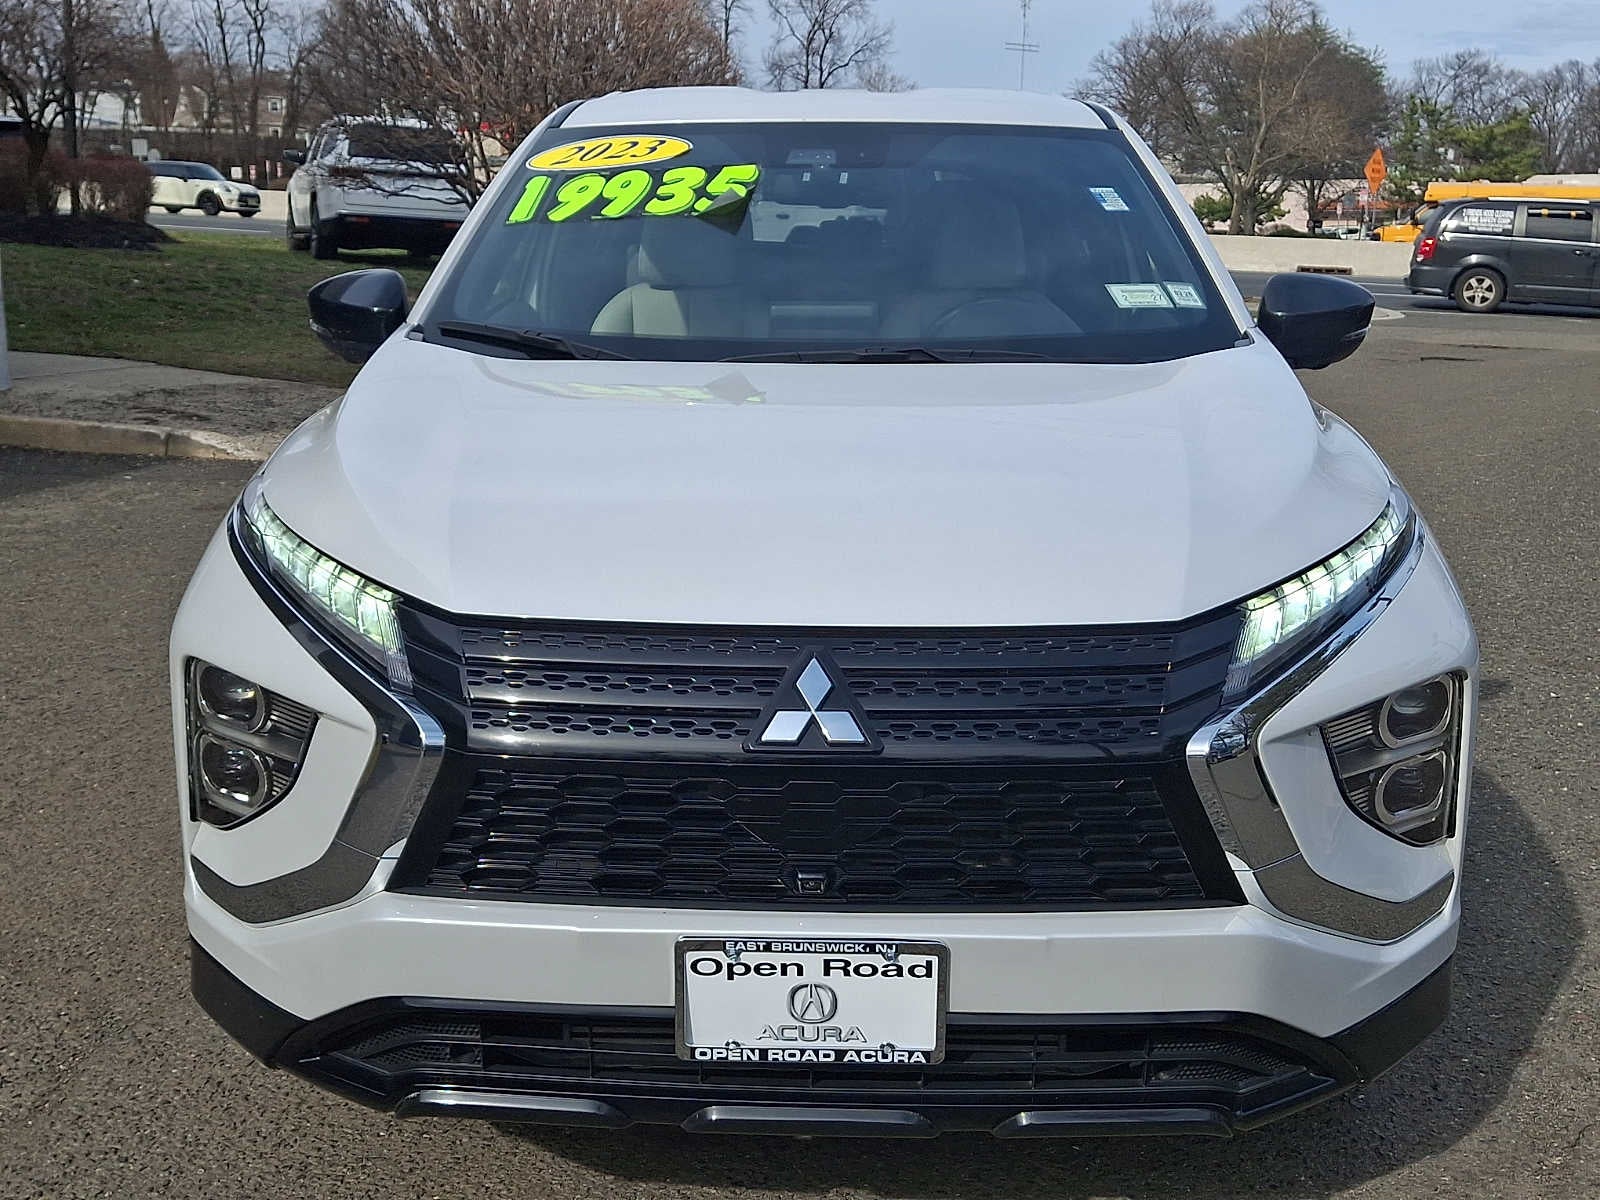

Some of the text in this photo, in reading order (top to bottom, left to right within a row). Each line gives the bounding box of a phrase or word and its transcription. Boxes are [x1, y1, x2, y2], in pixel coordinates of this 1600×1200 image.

[551, 139, 666, 165] 2023
[507, 164, 760, 223] 19935
[725, 941, 766, 950] EAST
[876, 943, 896, 954] NJ
[690, 957, 933, 981] Open Road
[756, 1024, 867, 1043] ACURA
[694, 1047, 928, 1063] OPEN ROAD ACURA
